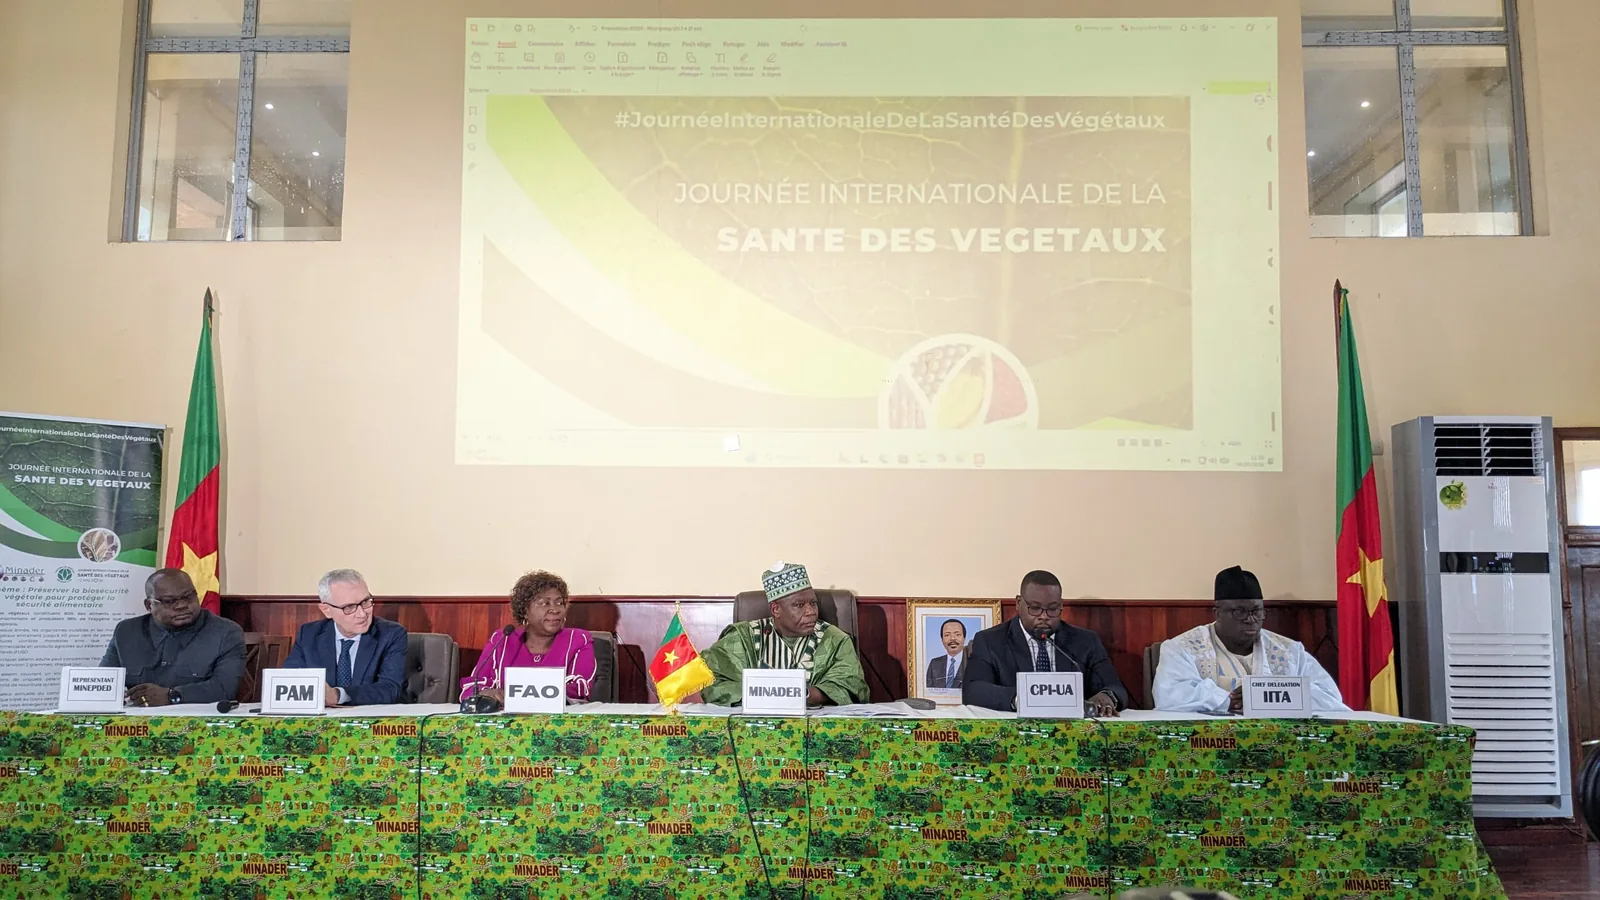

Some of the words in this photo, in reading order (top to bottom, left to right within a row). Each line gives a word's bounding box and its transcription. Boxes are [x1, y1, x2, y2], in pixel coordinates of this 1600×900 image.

[615, 111, 1165, 131] #JournéeInternationaleDeLaSantéDesVégétaux
[674, 177, 810, 205] JOURNÉE
[821, 183, 1073, 205] INTERNATIONALE
[1084, 183, 1121, 204] DE
[1132, 183, 1166, 204] LA
[716, 226, 845, 253] SANTE
[860, 226, 937, 253] DES
[950, 226, 1167, 253] VEGETAUX
[8, 463, 50, 473] JOURNÉE
[52, 466, 126, 477] INTERNATIONALE
[14, 474, 56, 484] SANTE
[60, 476, 84, 486] DES
[87, 478, 151, 490] VEGETAUX
[5, 566, 44, 575] Minader
[275, 685, 314, 701] PAM
[508, 684, 560, 698] FAO
[748, 686, 802, 698] MINADER
[1030, 684, 1074, 696] CPI-UA
[1264, 691, 1291, 703] IITA
[105, 726, 149, 737] MINADER
[372, 725, 416, 736] MINADER
[642, 725, 687, 736] MINADER
[914, 730, 959, 742] MINADER
[1190, 738, 1236, 749] MINADER
[240, 766, 284, 777] MINADER
[509, 767, 553, 778] MINADER
[782, 769, 826, 780] MINADER
[1055, 777, 1101, 789] MINADER
[1334, 782, 1379, 793] MINADER
[107, 822, 150, 833] MINADER
[648, 824, 693, 835] MINADER
[922, 828, 967, 840] MINADER
[1200, 835, 1246, 847] MINADER
[243, 863, 287, 874] MINADER
[515, 865, 559, 876] MINADER
[788, 867, 834, 879] MINADER
[1345, 879, 1391, 890] MINADER
